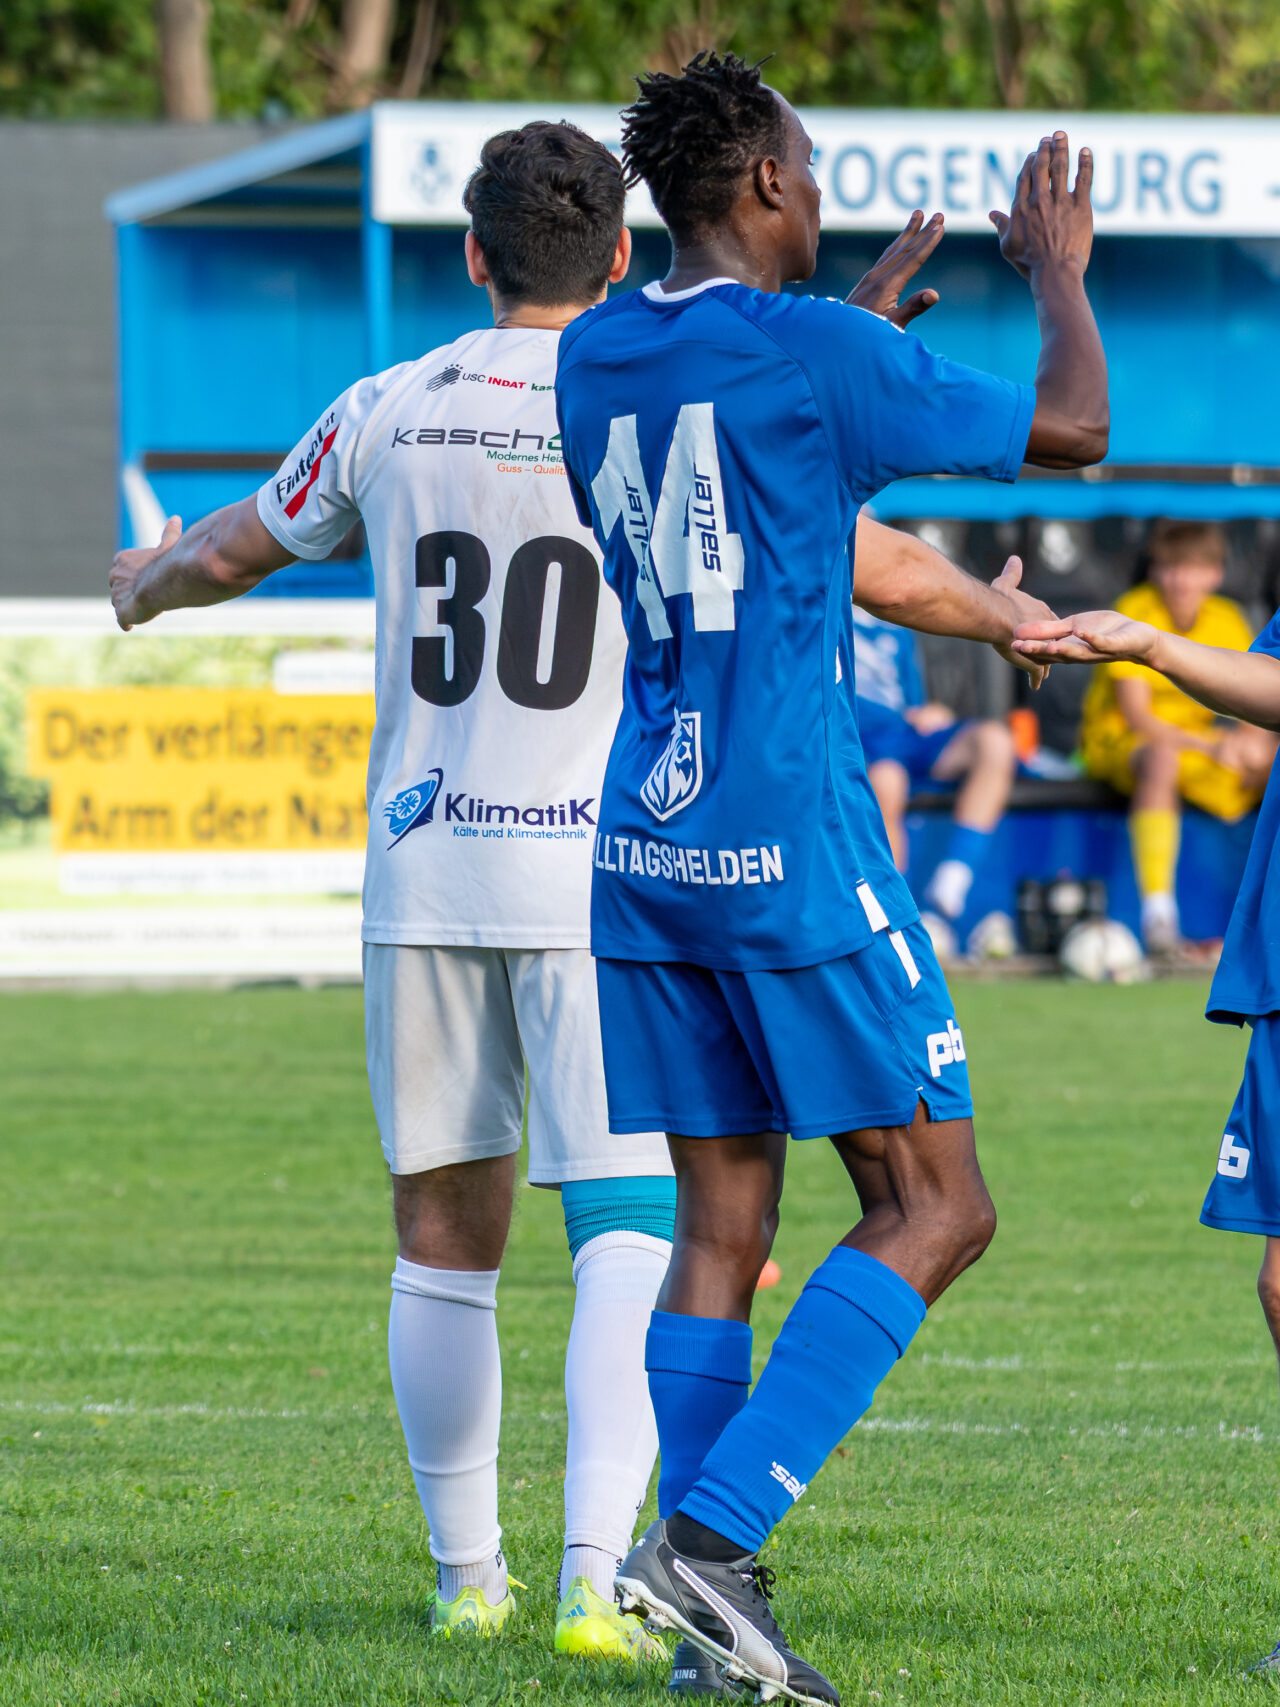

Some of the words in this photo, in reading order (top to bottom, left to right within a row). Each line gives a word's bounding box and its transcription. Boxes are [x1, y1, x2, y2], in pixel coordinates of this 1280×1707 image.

[811, 143, 1222, 215] OGENURG
[462, 372, 486, 383] USC
[487, 376, 527, 389] INDAT
[486, 449, 539, 462] Modernes
[541, 453, 566, 464] Heiz
[497, 462, 522, 474] Guss
[692, 460, 723, 574] saller
[410, 529, 601, 711] 30
[45, 709, 128, 762] Der
[147, 703, 374, 778] verlänge
[67, 794, 175, 843] Arm
[190, 788, 269, 843] der
[288, 793, 368, 843] Na
[444, 792, 599, 827] KlimatiK
[453, 825, 479, 838] Kälte
[481, 827, 504, 838] und
[507, 827, 588, 840] Klimatechnik
[592, 832, 785, 886] LLTAGSHELDEN
[673, 1669, 698, 1681] KING
